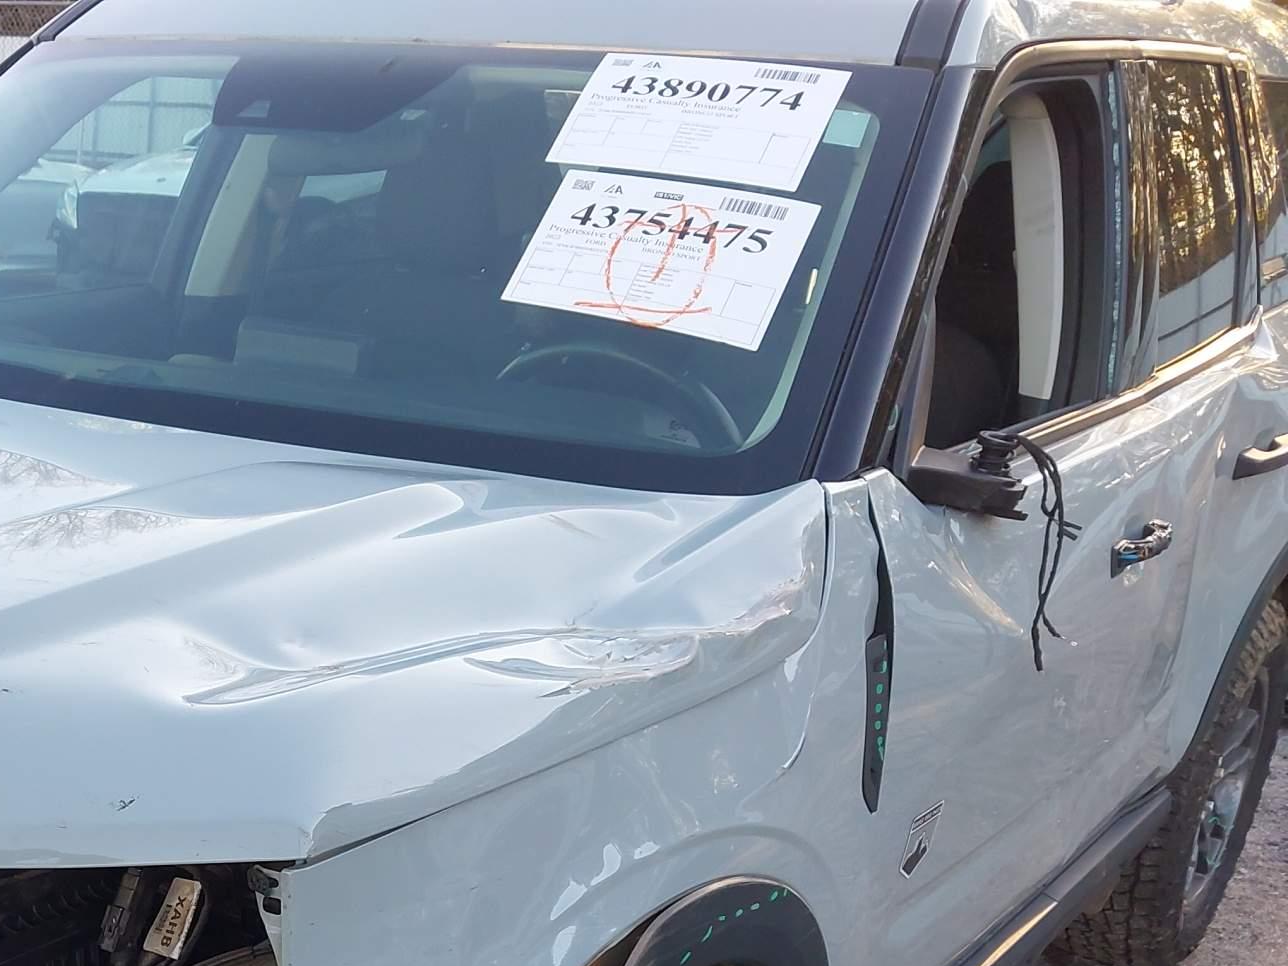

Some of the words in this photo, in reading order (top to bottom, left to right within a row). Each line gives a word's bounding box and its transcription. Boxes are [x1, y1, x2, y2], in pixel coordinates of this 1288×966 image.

[591, 93, 646, 103] Progressive
[649, 98, 689, 108] Casualty
[694, 101, 742, 113] Insurance
[612, 75, 805, 112] 43890774
[549, 223, 607, 238] Progressive
[570, 203, 774, 253] 43754475
